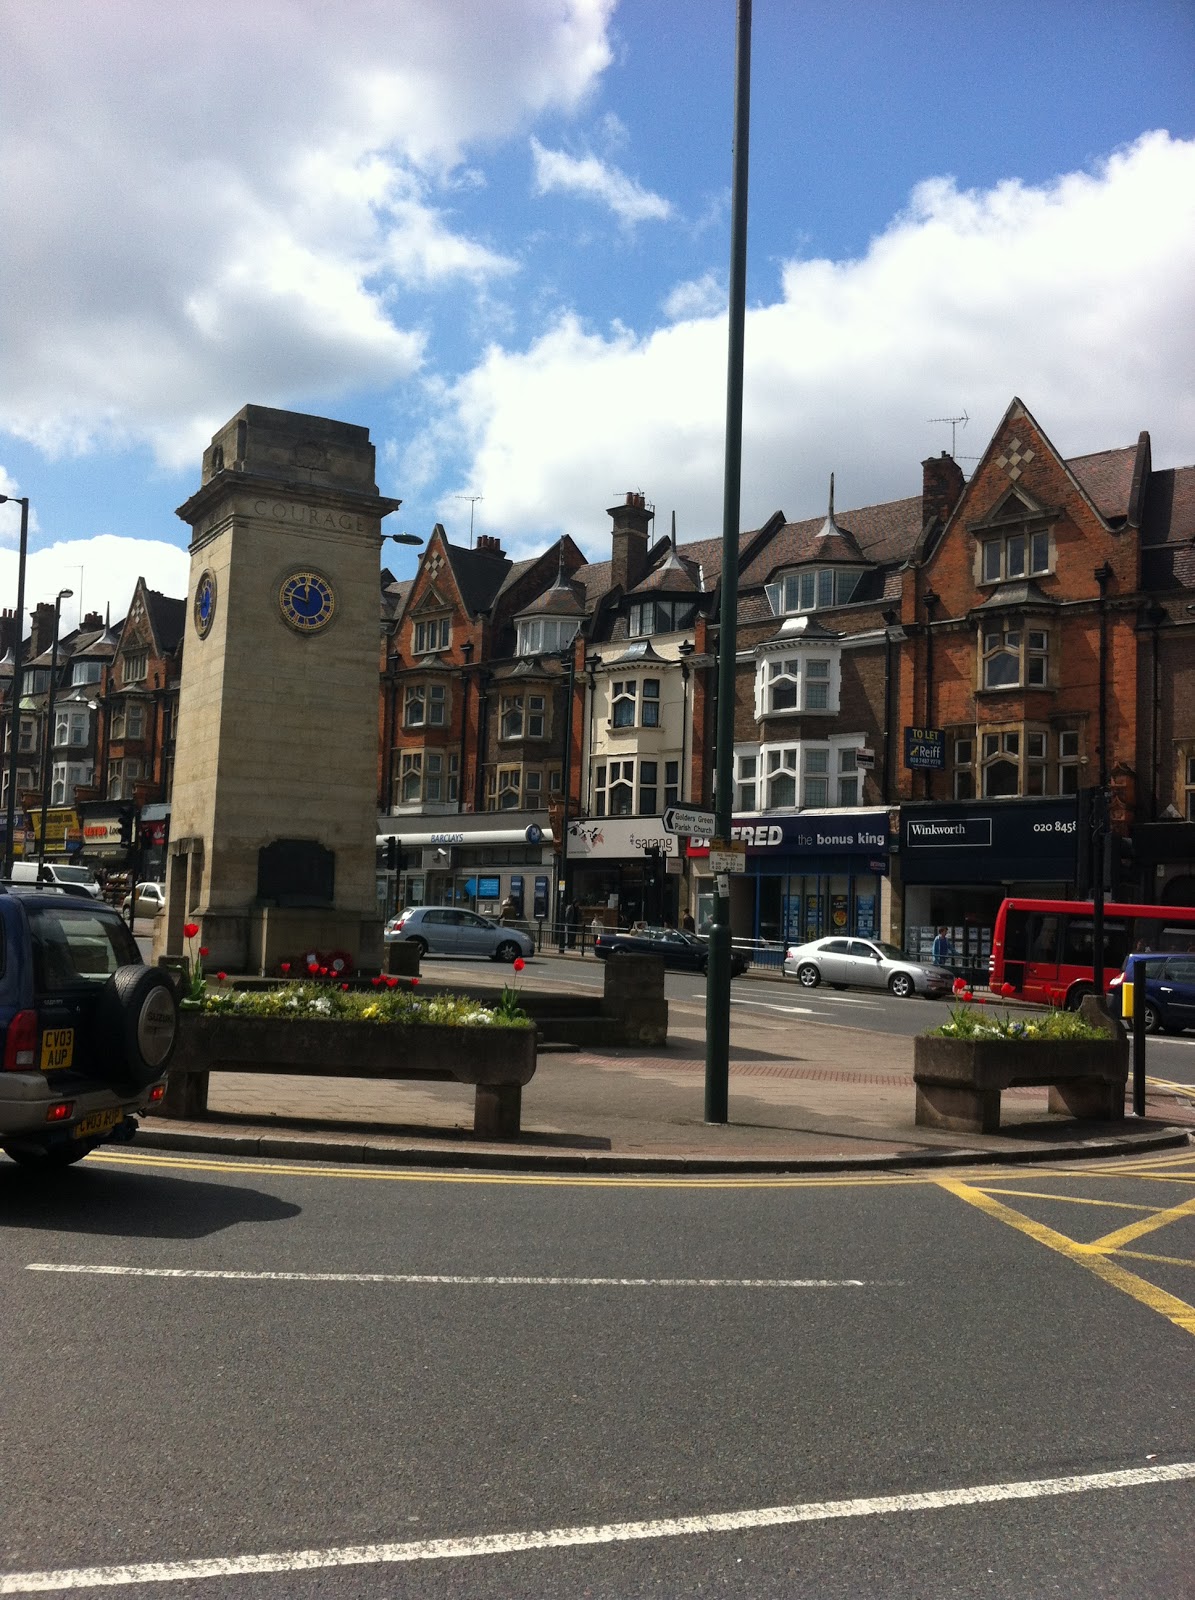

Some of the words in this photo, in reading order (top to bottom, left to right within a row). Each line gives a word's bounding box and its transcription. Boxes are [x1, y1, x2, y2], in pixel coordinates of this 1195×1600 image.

[254, 501, 365, 532] COURAGE
[912, 729, 923, 739] TO
[925, 730, 939, 740] LET
[920, 745, 941, 759] Reiff
[675, 813, 695, 822] Golders
[698, 816, 713, 824] Green
[675, 823, 691, 831] Parish
[694, 825, 712, 834] Church
[911, 824, 966, 835] Winkworth
[1033, 823, 1053, 832] 020
[431, 834, 464, 843] BARCLAYS
[798, 834, 813, 846] the
[817, 834, 854, 846] bonus
[858, 832, 885, 847] king
[635, 838, 673, 852] sarang
[45, 1030, 72, 1048] CV03
[48, 1049, 67, 1066] AUP
